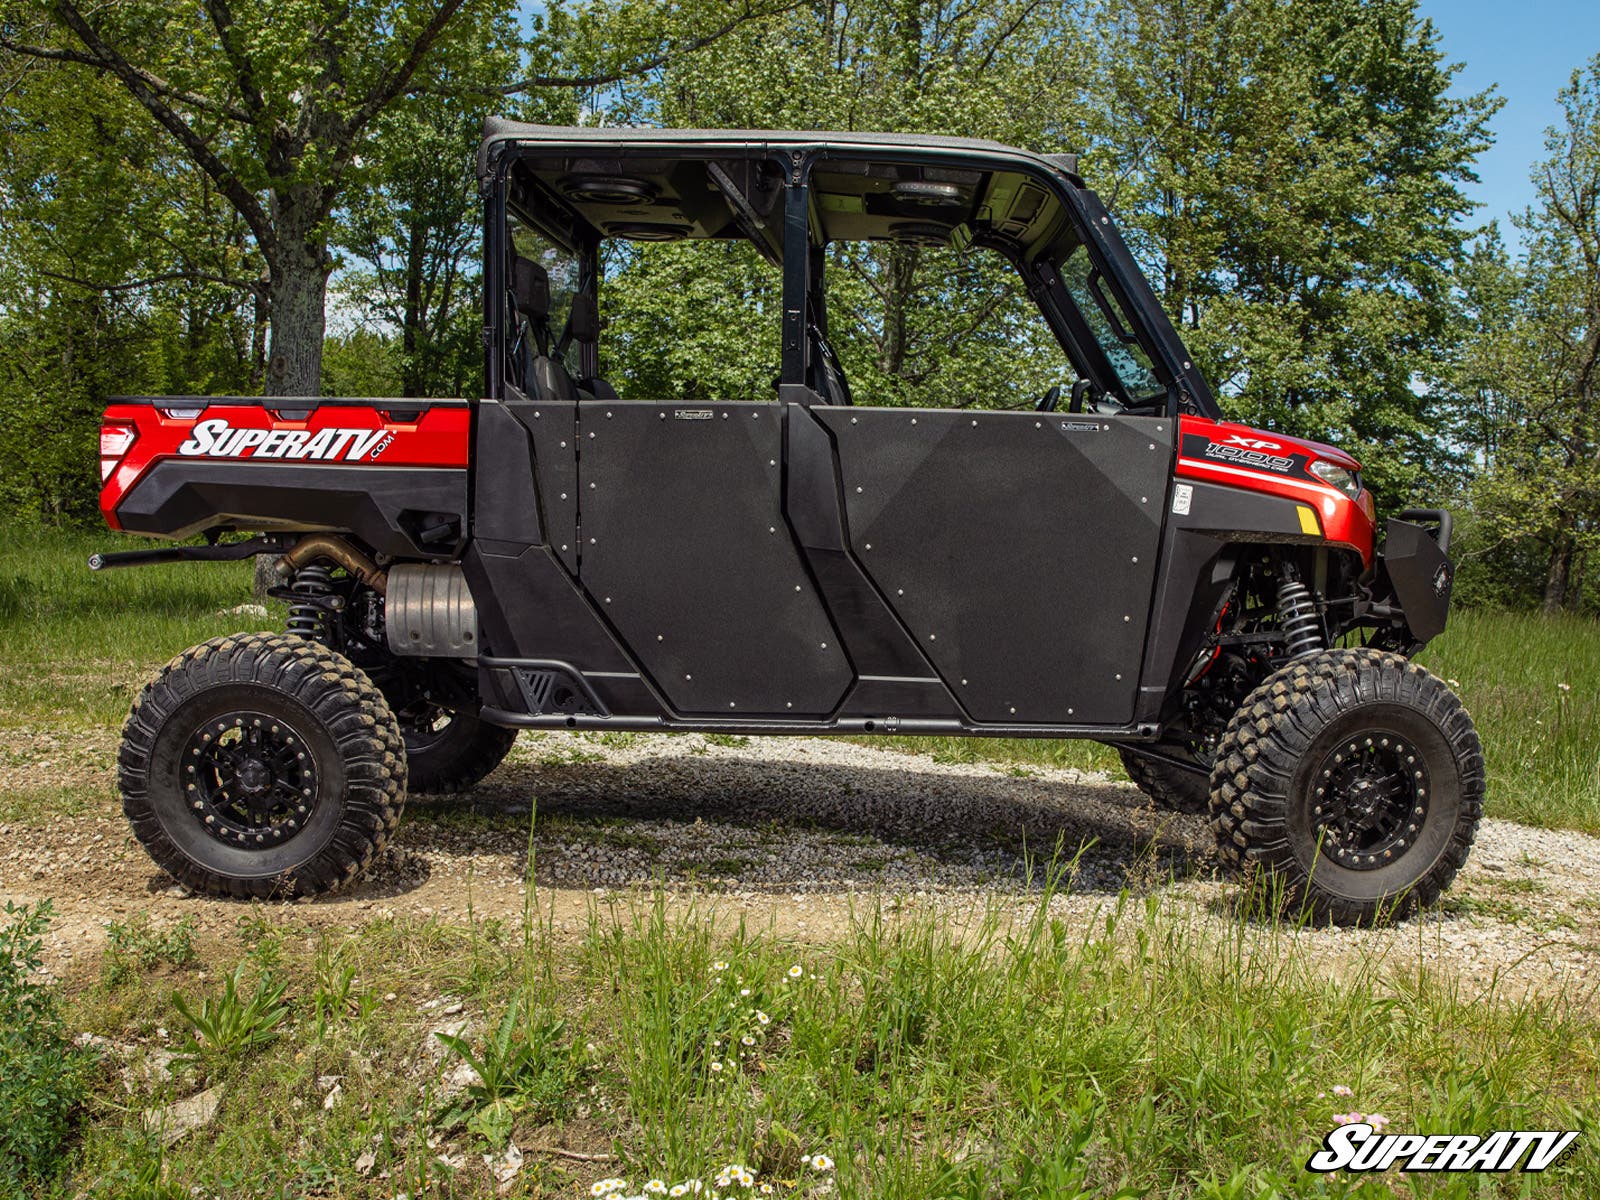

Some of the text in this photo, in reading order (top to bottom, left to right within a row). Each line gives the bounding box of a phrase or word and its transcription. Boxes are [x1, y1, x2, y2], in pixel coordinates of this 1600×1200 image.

[179, 419, 388, 461] SUPERATV
[1222, 434, 1282, 450] XP
[1205, 442, 1294, 469] 1000
